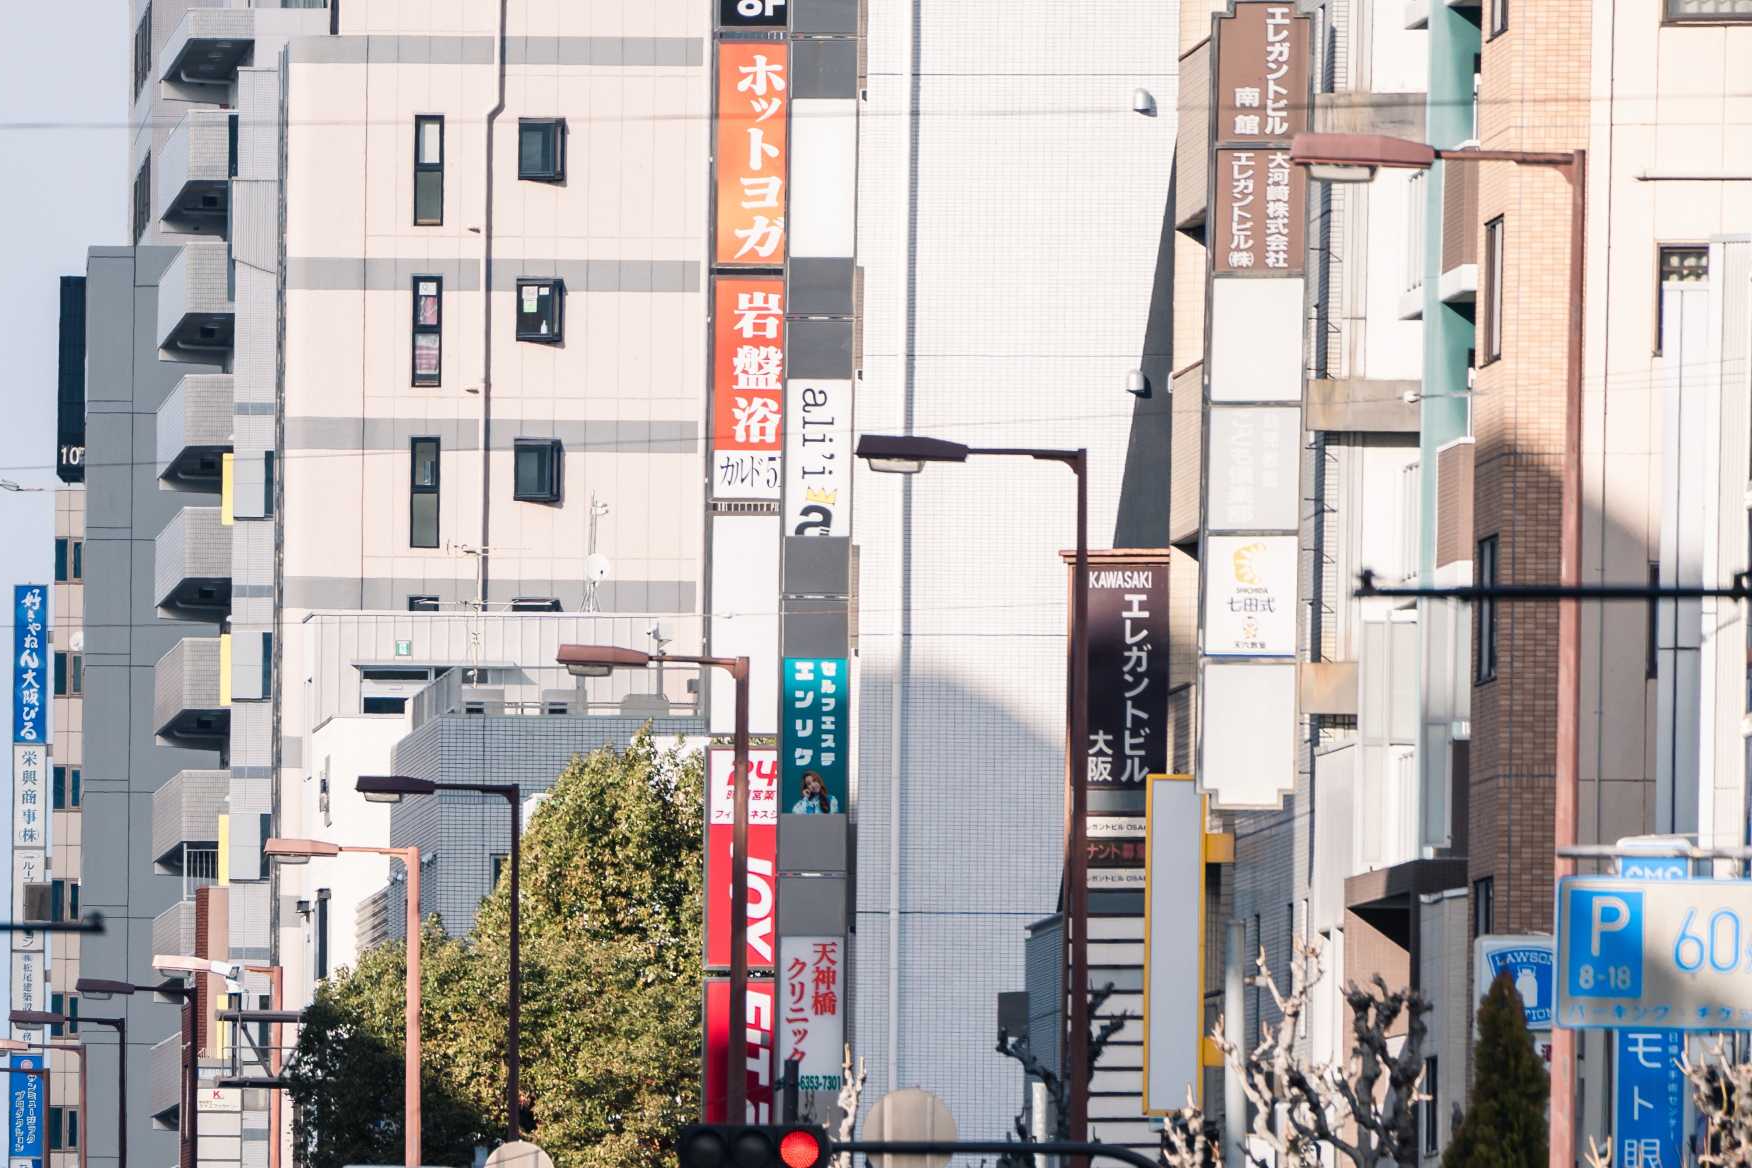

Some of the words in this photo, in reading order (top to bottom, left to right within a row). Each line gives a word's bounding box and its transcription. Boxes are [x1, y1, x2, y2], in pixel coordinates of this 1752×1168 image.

[1264, 7, 1290, 135] エレガントビル
[1233, 87, 1260, 135] 南館
[734, 54, 785, 259] ホットヨガ
[732, 292, 782, 443] 岩盤浴
[720, 455, 762, 488] カルド
[766, 457, 782, 489] 5
[1089, 571, 1152, 589] KAWASAKI
[1228, 598, 1276, 613] 七田式
[20, 589, 42, 741] 好きやねん大阪びる
[1120, 593, 1152, 783] エレガントビル
[794, 661, 814, 766] エンリケ
[820, 661, 837, 766] セルフエステ
[1087, 730, 1114, 781] 大阪
[1591, 895, 1631, 957] P
[1674, 906, 1752, 973] 60
[786, 957, 808, 1062] クリニック
[812, 941, 837, 1016] 天神橋
[1578, 963, 1631, 991] 8-18
